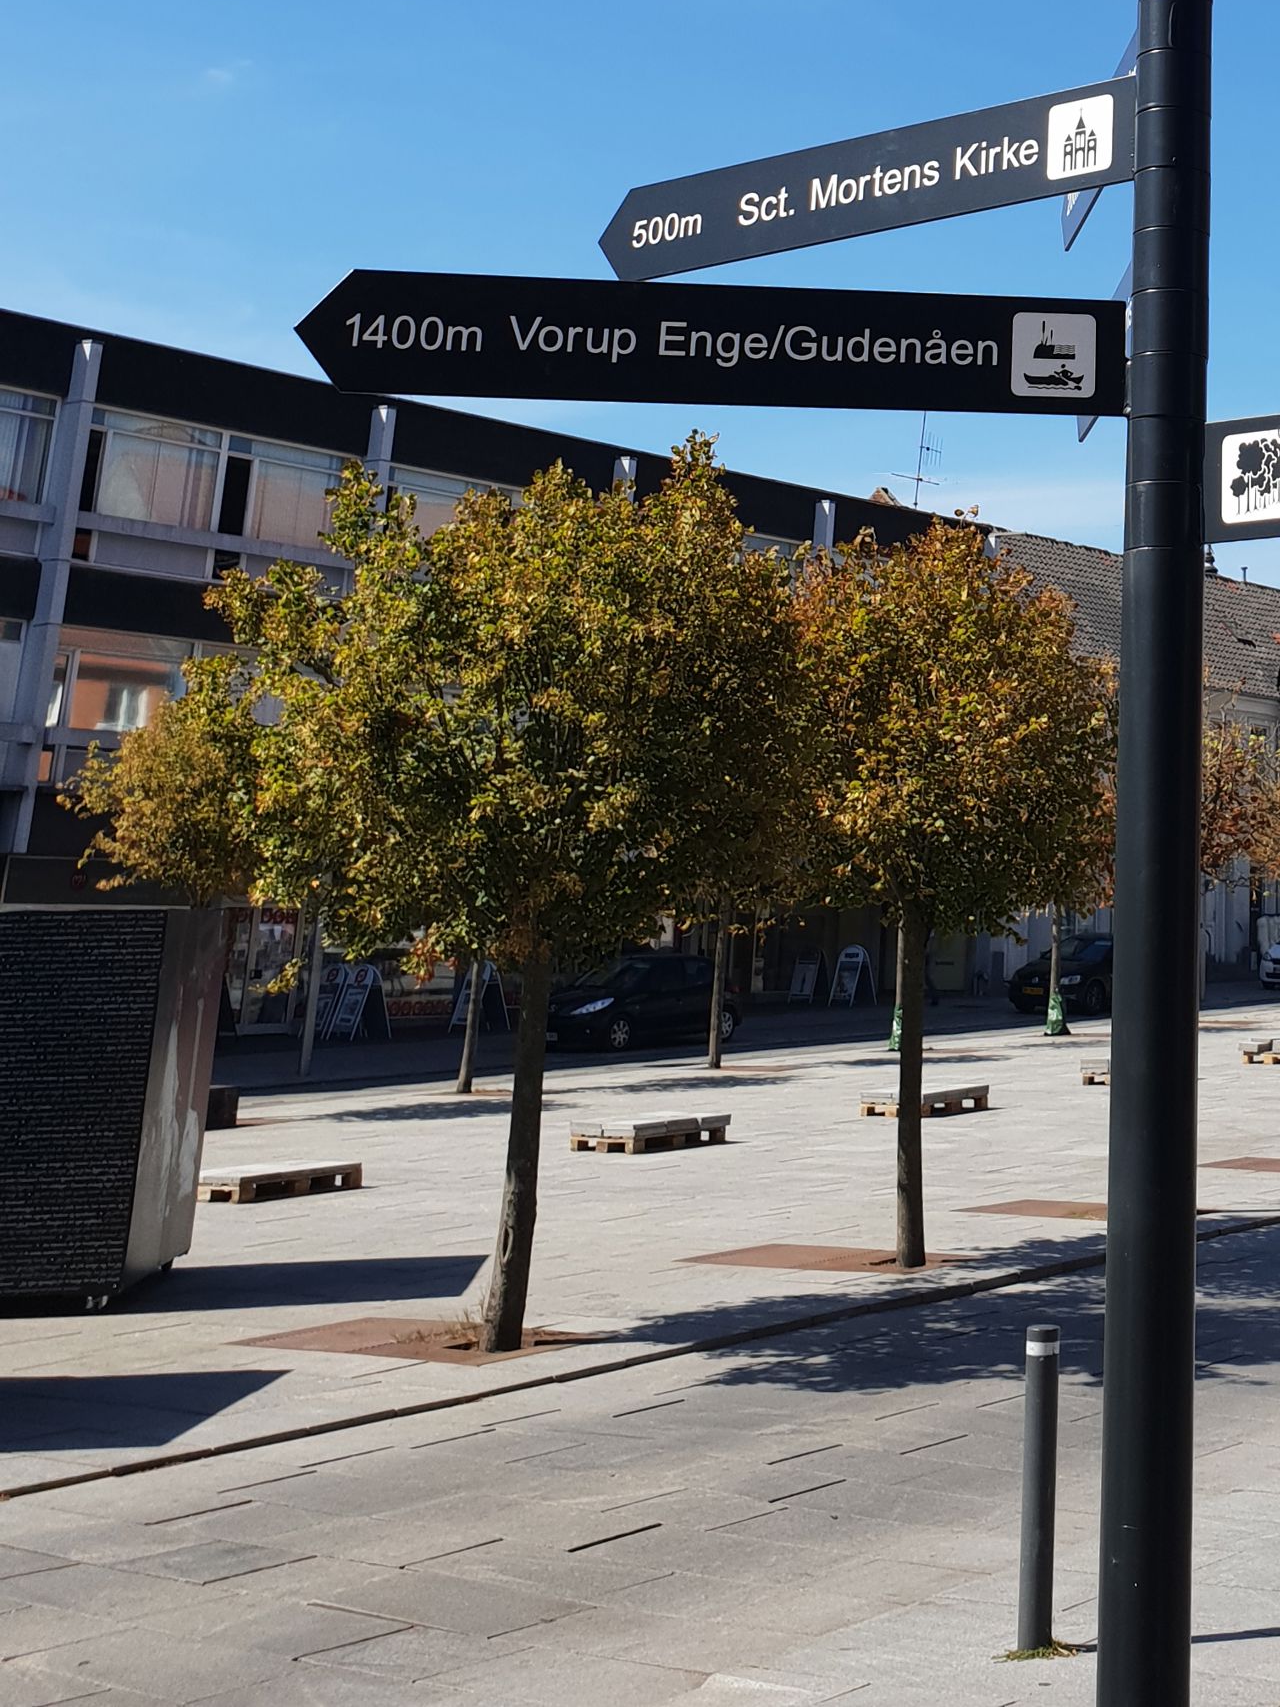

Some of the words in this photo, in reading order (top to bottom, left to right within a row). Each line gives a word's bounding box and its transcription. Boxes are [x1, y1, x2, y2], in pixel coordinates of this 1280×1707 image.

[631, 212, 703, 250] 500m
[737, 186, 796, 227] Sct.
[809, 160, 940, 212] Mortens
[953, 136, 1040, 181] Kirke
[345, 313, 483, 352] 1400m
[509, 315, 637, 363] Vorup
[658, 321, 999, 368] Enge/Gudenåen
